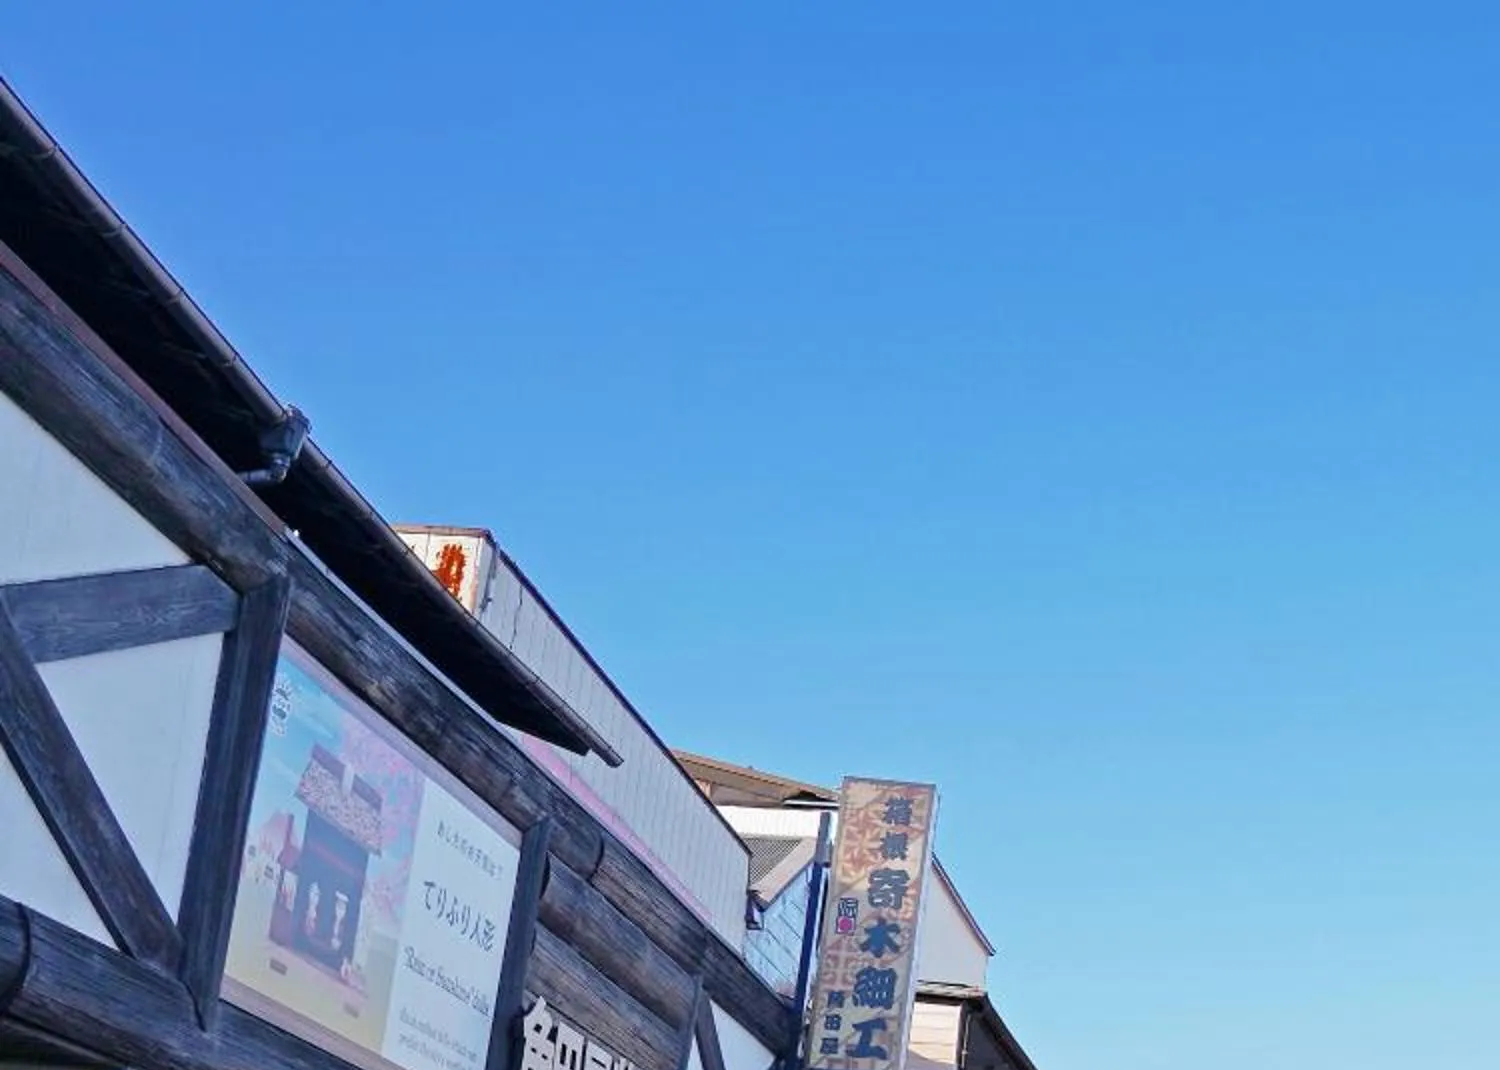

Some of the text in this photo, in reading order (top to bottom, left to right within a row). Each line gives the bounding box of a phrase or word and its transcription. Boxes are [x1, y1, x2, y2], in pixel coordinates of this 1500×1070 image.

[422, 880, 497, 953] てりふり人形
